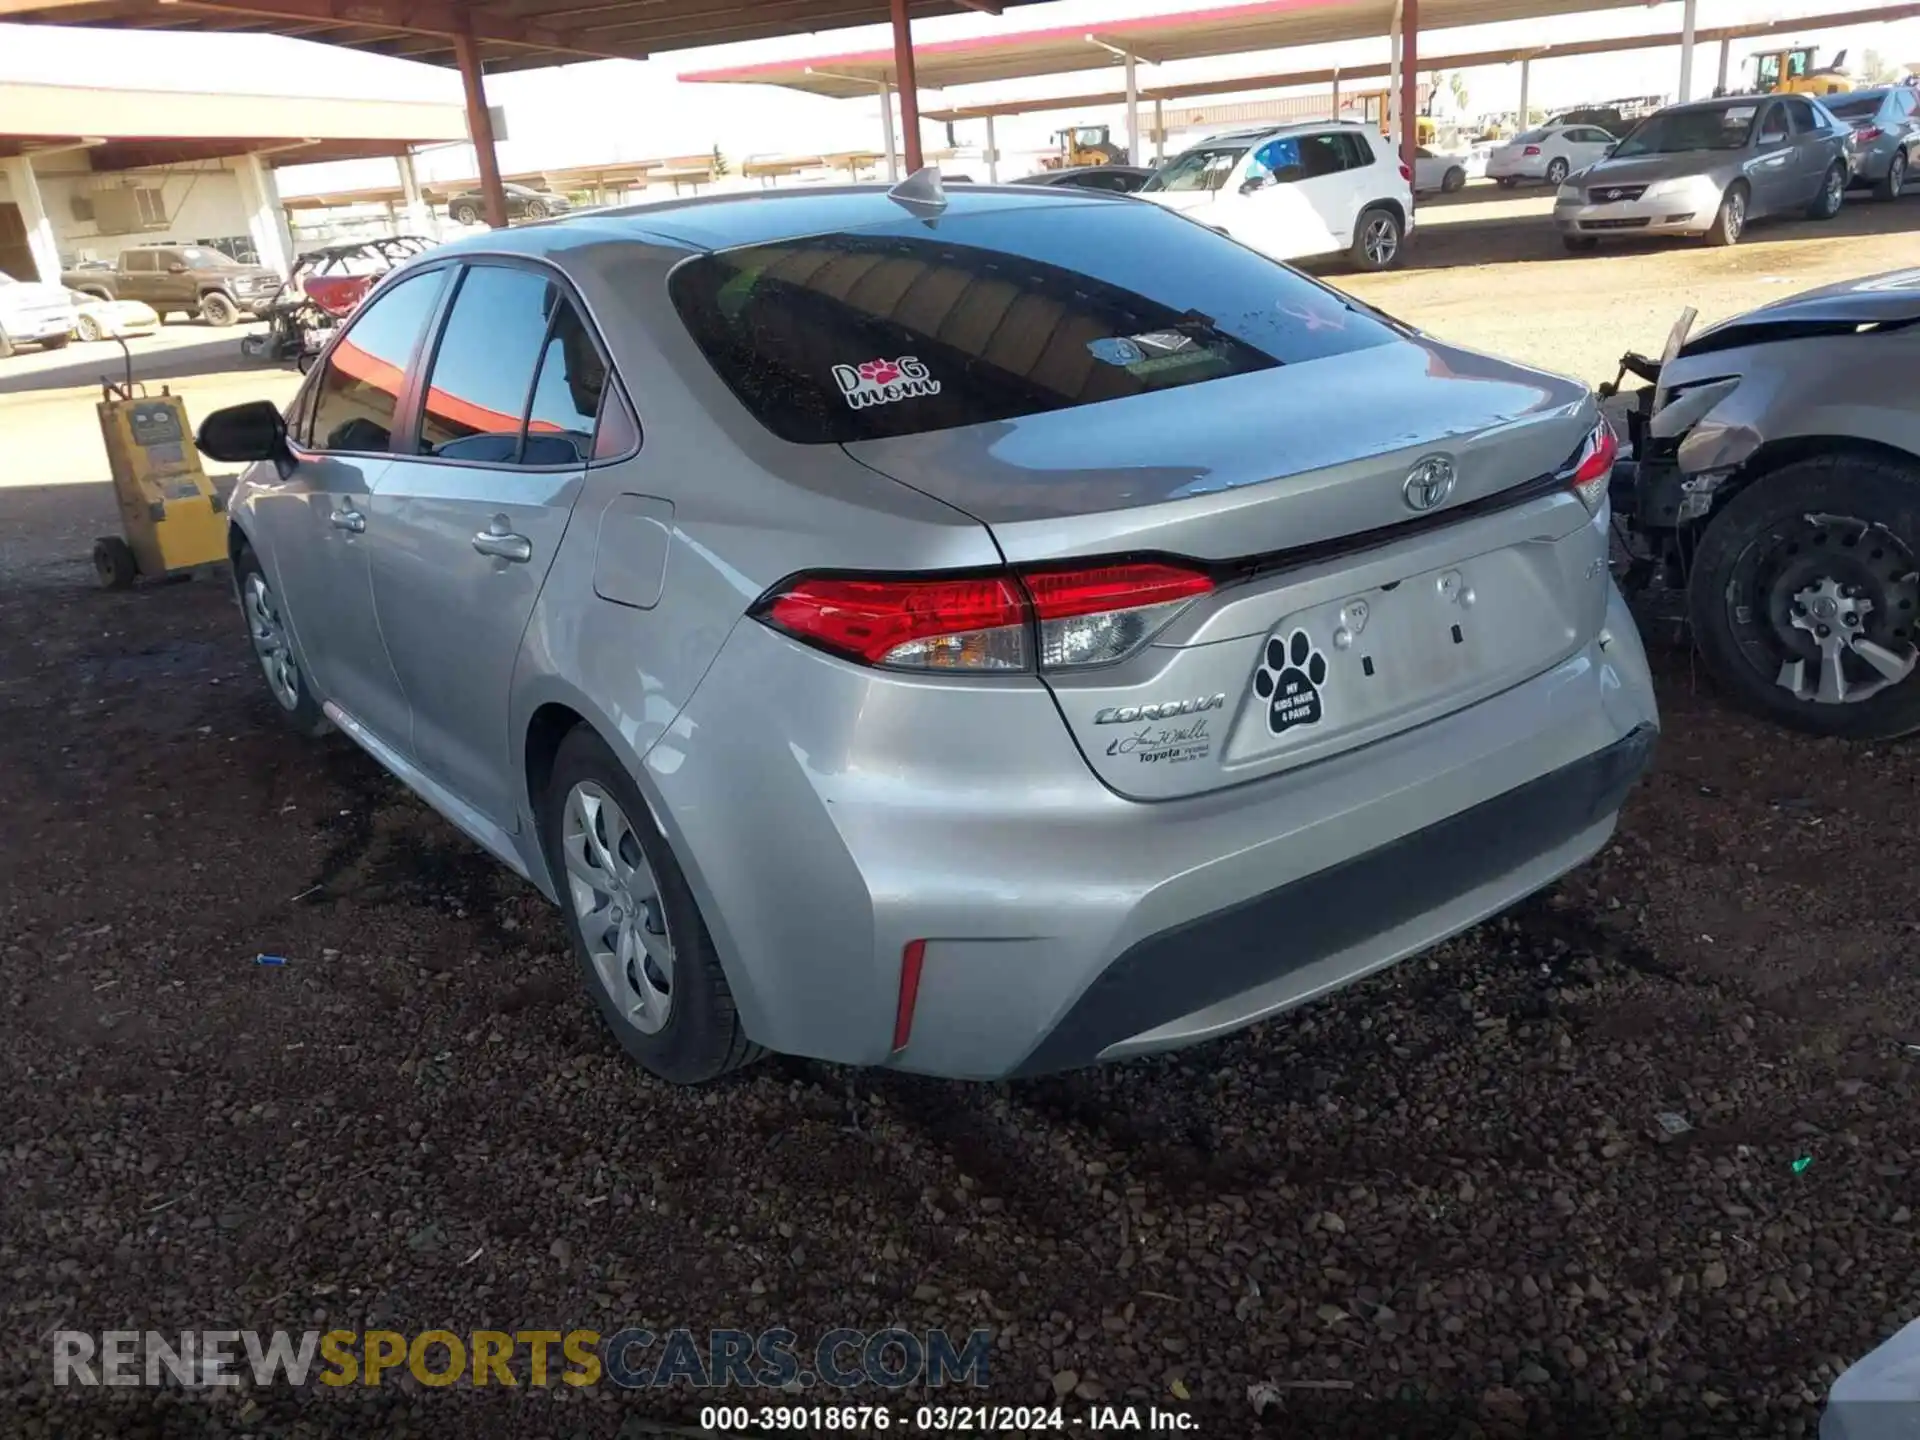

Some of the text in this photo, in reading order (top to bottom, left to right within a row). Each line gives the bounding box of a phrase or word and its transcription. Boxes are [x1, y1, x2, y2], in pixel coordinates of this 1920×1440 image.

[847, 379, 940, 408] mom
[1093, 692, 1225, 725] COROLLA
[1288, 705, 1311, 720] PAWS
[1139, 748, 1180, 763] Toyota
